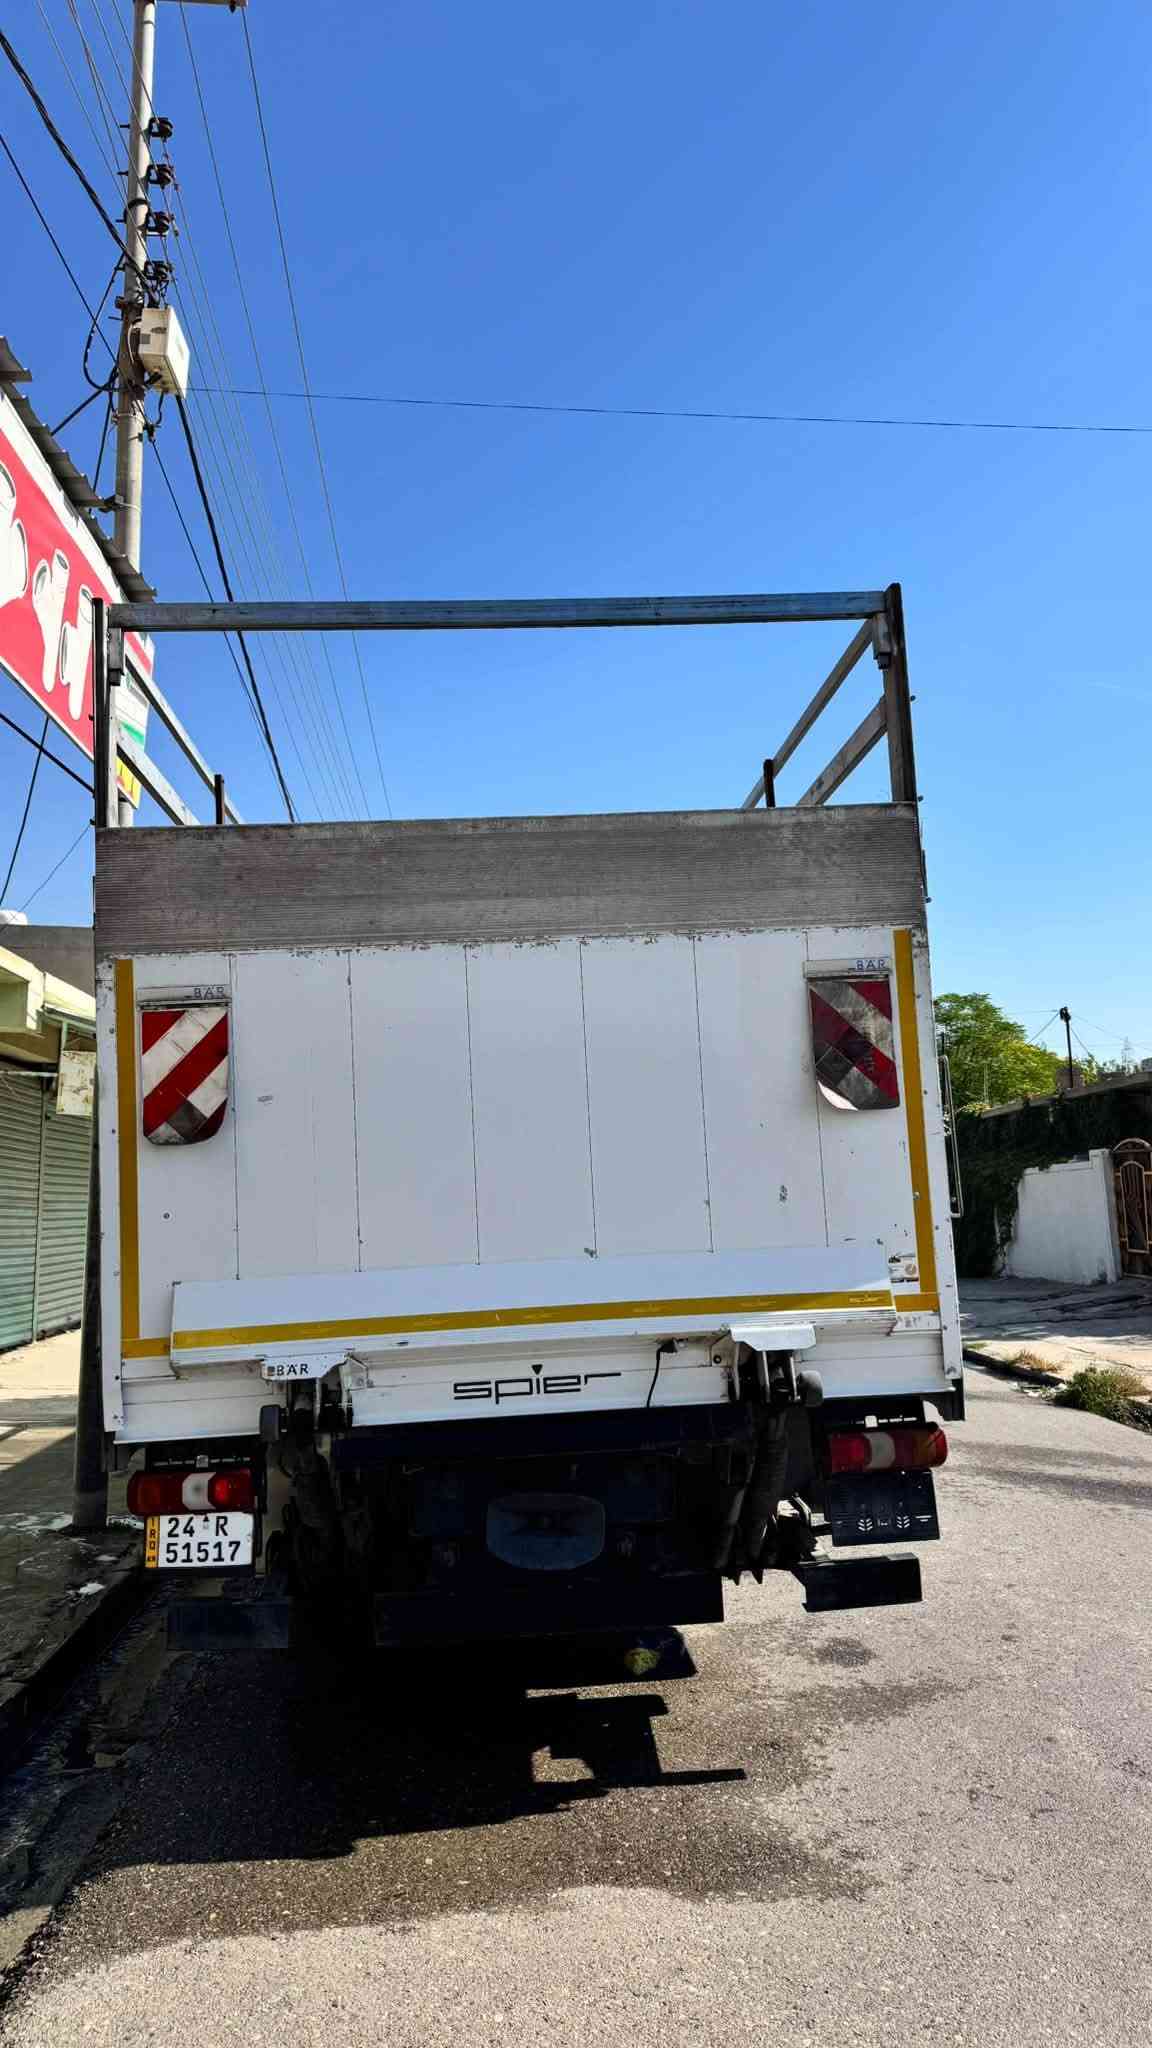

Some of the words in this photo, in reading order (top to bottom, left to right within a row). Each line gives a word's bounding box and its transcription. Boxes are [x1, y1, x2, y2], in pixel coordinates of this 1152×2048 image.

[453, 1364, 622, 1405] spier
[167, 1516, 195, 1538] 24
[215, 1515, 229, 1537] R
[165, 1540, 241, 1564] 51517
